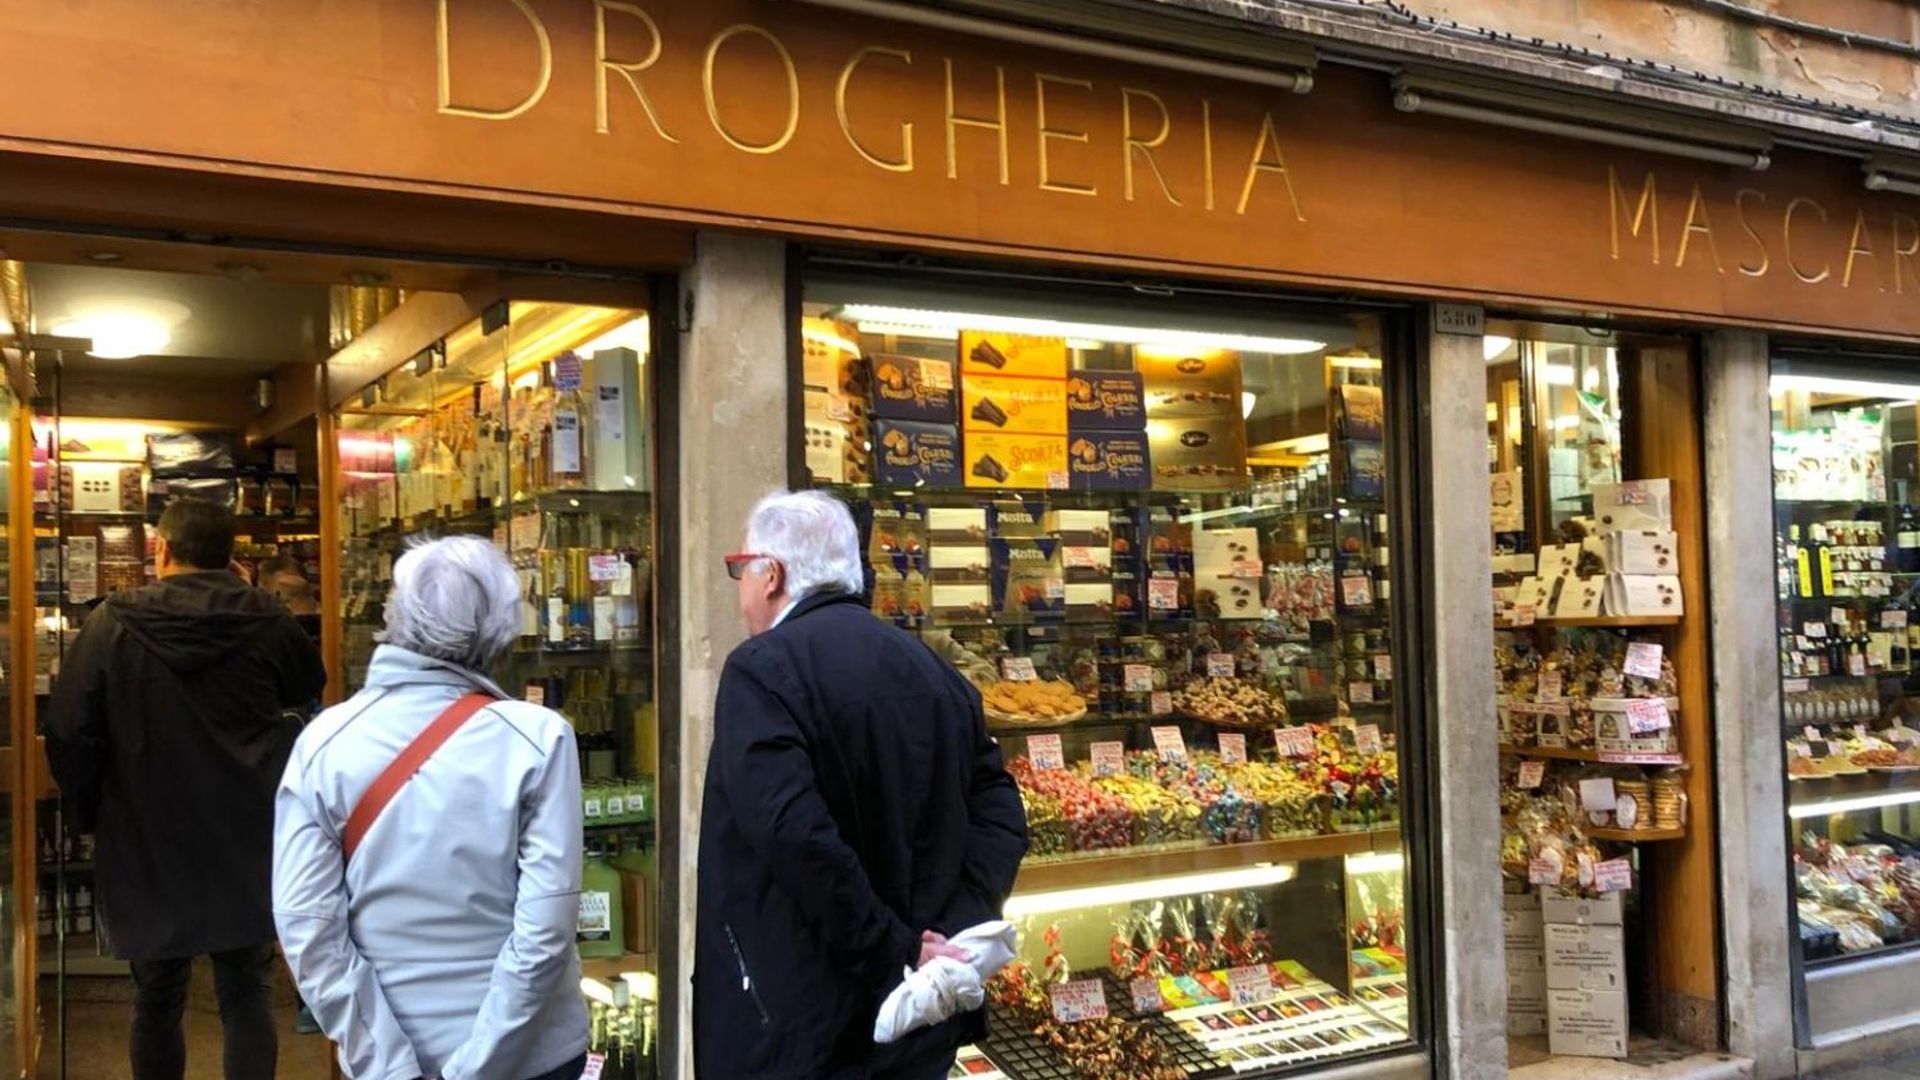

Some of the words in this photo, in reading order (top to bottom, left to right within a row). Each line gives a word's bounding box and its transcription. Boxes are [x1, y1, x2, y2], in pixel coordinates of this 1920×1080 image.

[436, 0, 1307, 222] DROGHERIA
[1608, 164, 1920, 294] MASCAR
[997, 511, 1034, 523] Motta
[1008, 548, 1046, 559] Motta
